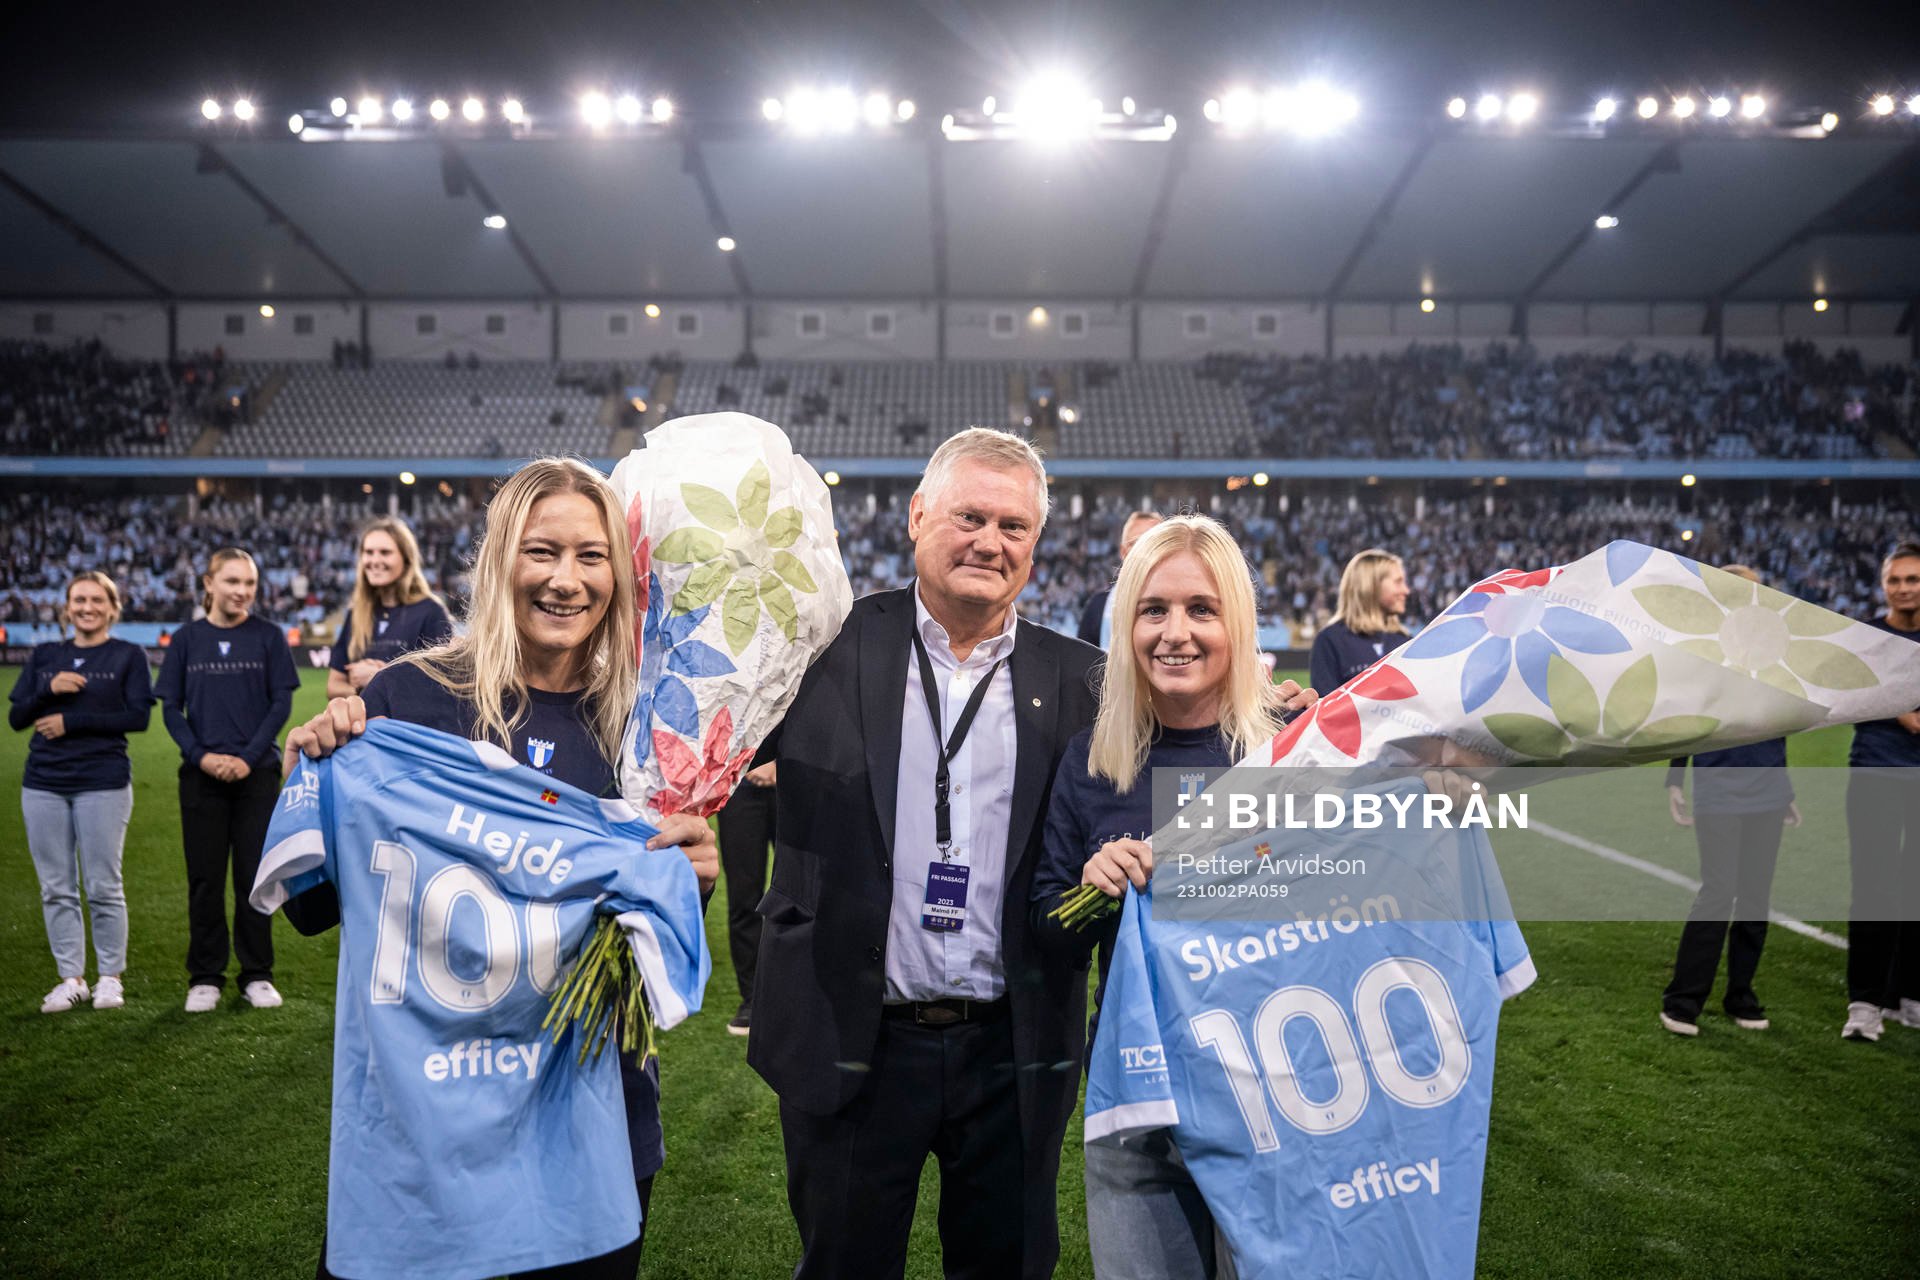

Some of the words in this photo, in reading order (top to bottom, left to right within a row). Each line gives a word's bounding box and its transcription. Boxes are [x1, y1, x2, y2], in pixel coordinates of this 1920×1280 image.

[445, 803, 574, 885] Hejde
[937, 897, 954, 906] 2023
[940, 875, 966, 884] PASSAGE
[1180, 893, 1402, 982] Skarström
[423, 1038, 542, 1081] efficy
[1119, 1044, 1167, 1069] TICT
[1188, 956, 1473, 1154] 100
[1330, 1158, 1440, 1209] efficy
